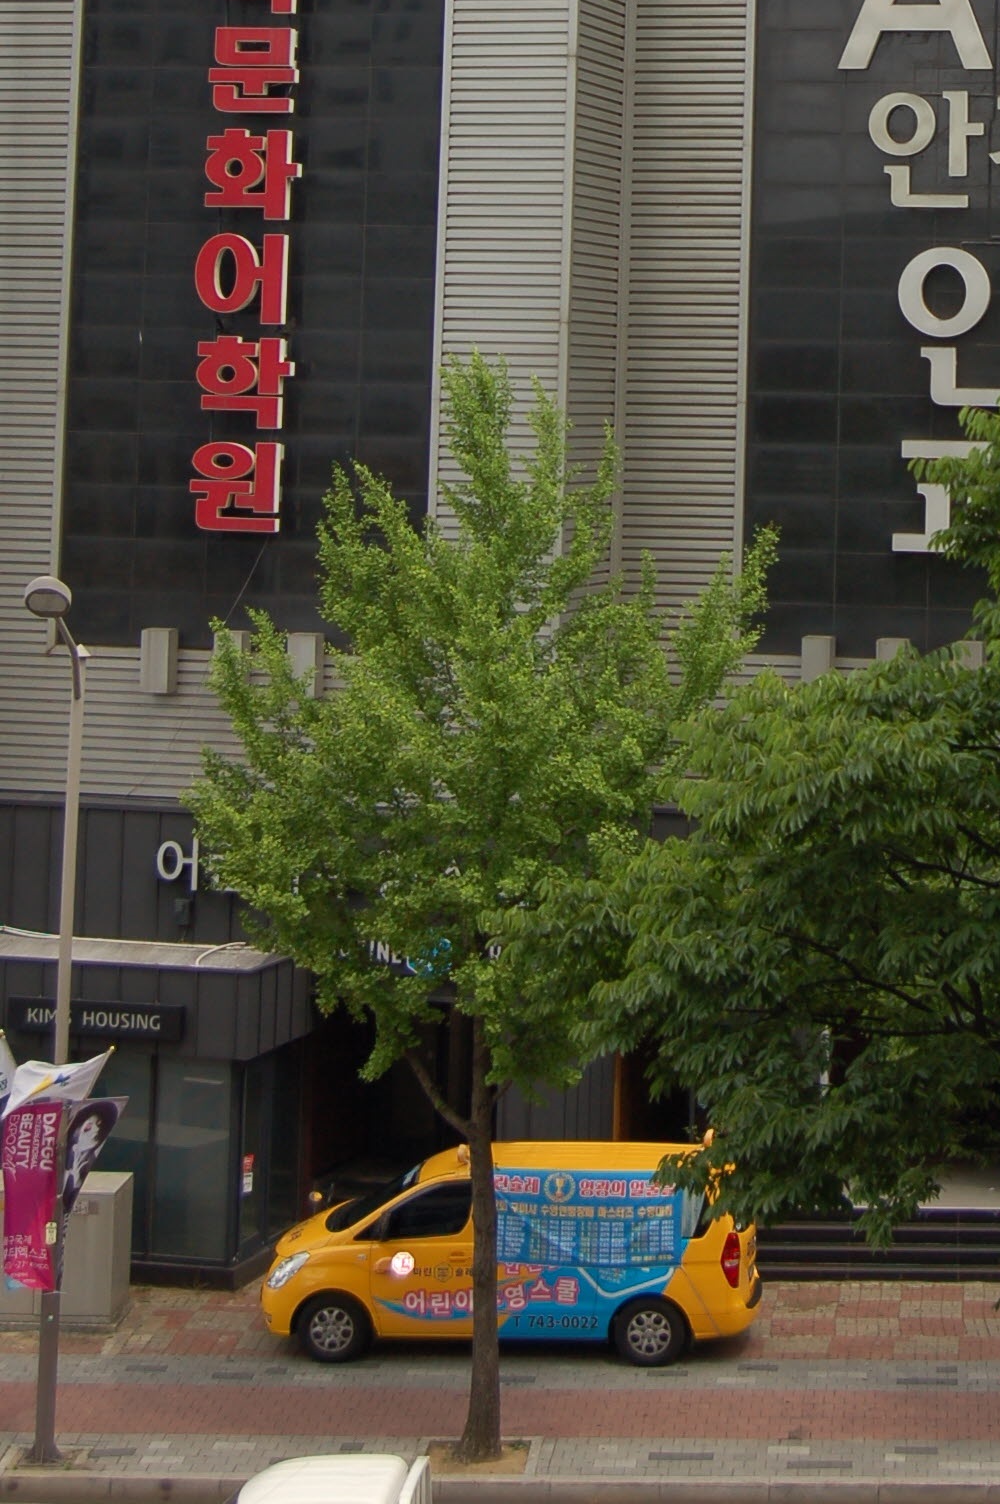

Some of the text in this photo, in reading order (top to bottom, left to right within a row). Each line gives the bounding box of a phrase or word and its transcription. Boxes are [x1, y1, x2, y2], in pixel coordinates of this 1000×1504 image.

[82, 1010, 161, 1031] HOUSING
[15, 1112, 34, 1169] BEAUTY
[40, 1112, 57, 1171] DAEGU
[529, 1316, 598, 1328] 743-0022
